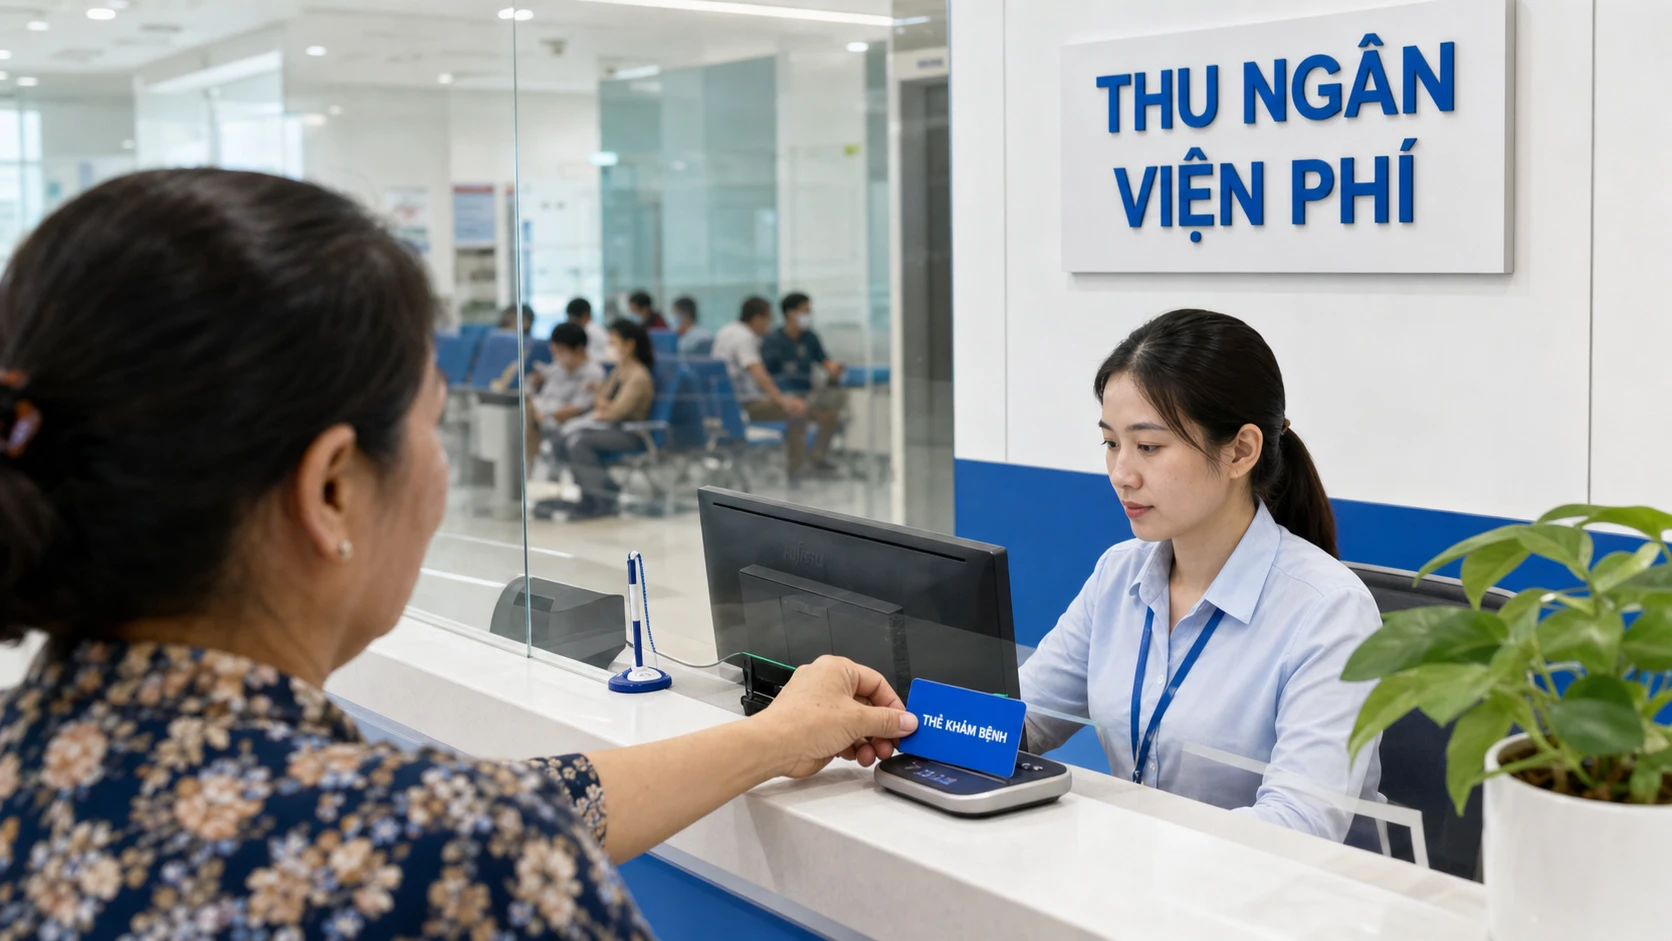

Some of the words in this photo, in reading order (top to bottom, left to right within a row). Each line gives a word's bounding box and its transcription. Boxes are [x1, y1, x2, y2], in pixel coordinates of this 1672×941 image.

[1096, 64, 1219, 133] THU
[1243, 33, 1455, 125] NGÂN
[1113, 147, 1264, 243] VIỆN
[1291, 138, 1418, 225] PHÍ
[923, 714, 943, 729] THẺ
[945, 720, 977, 736] KHÁM
[978, 726, 1008, 743] BỆNH
